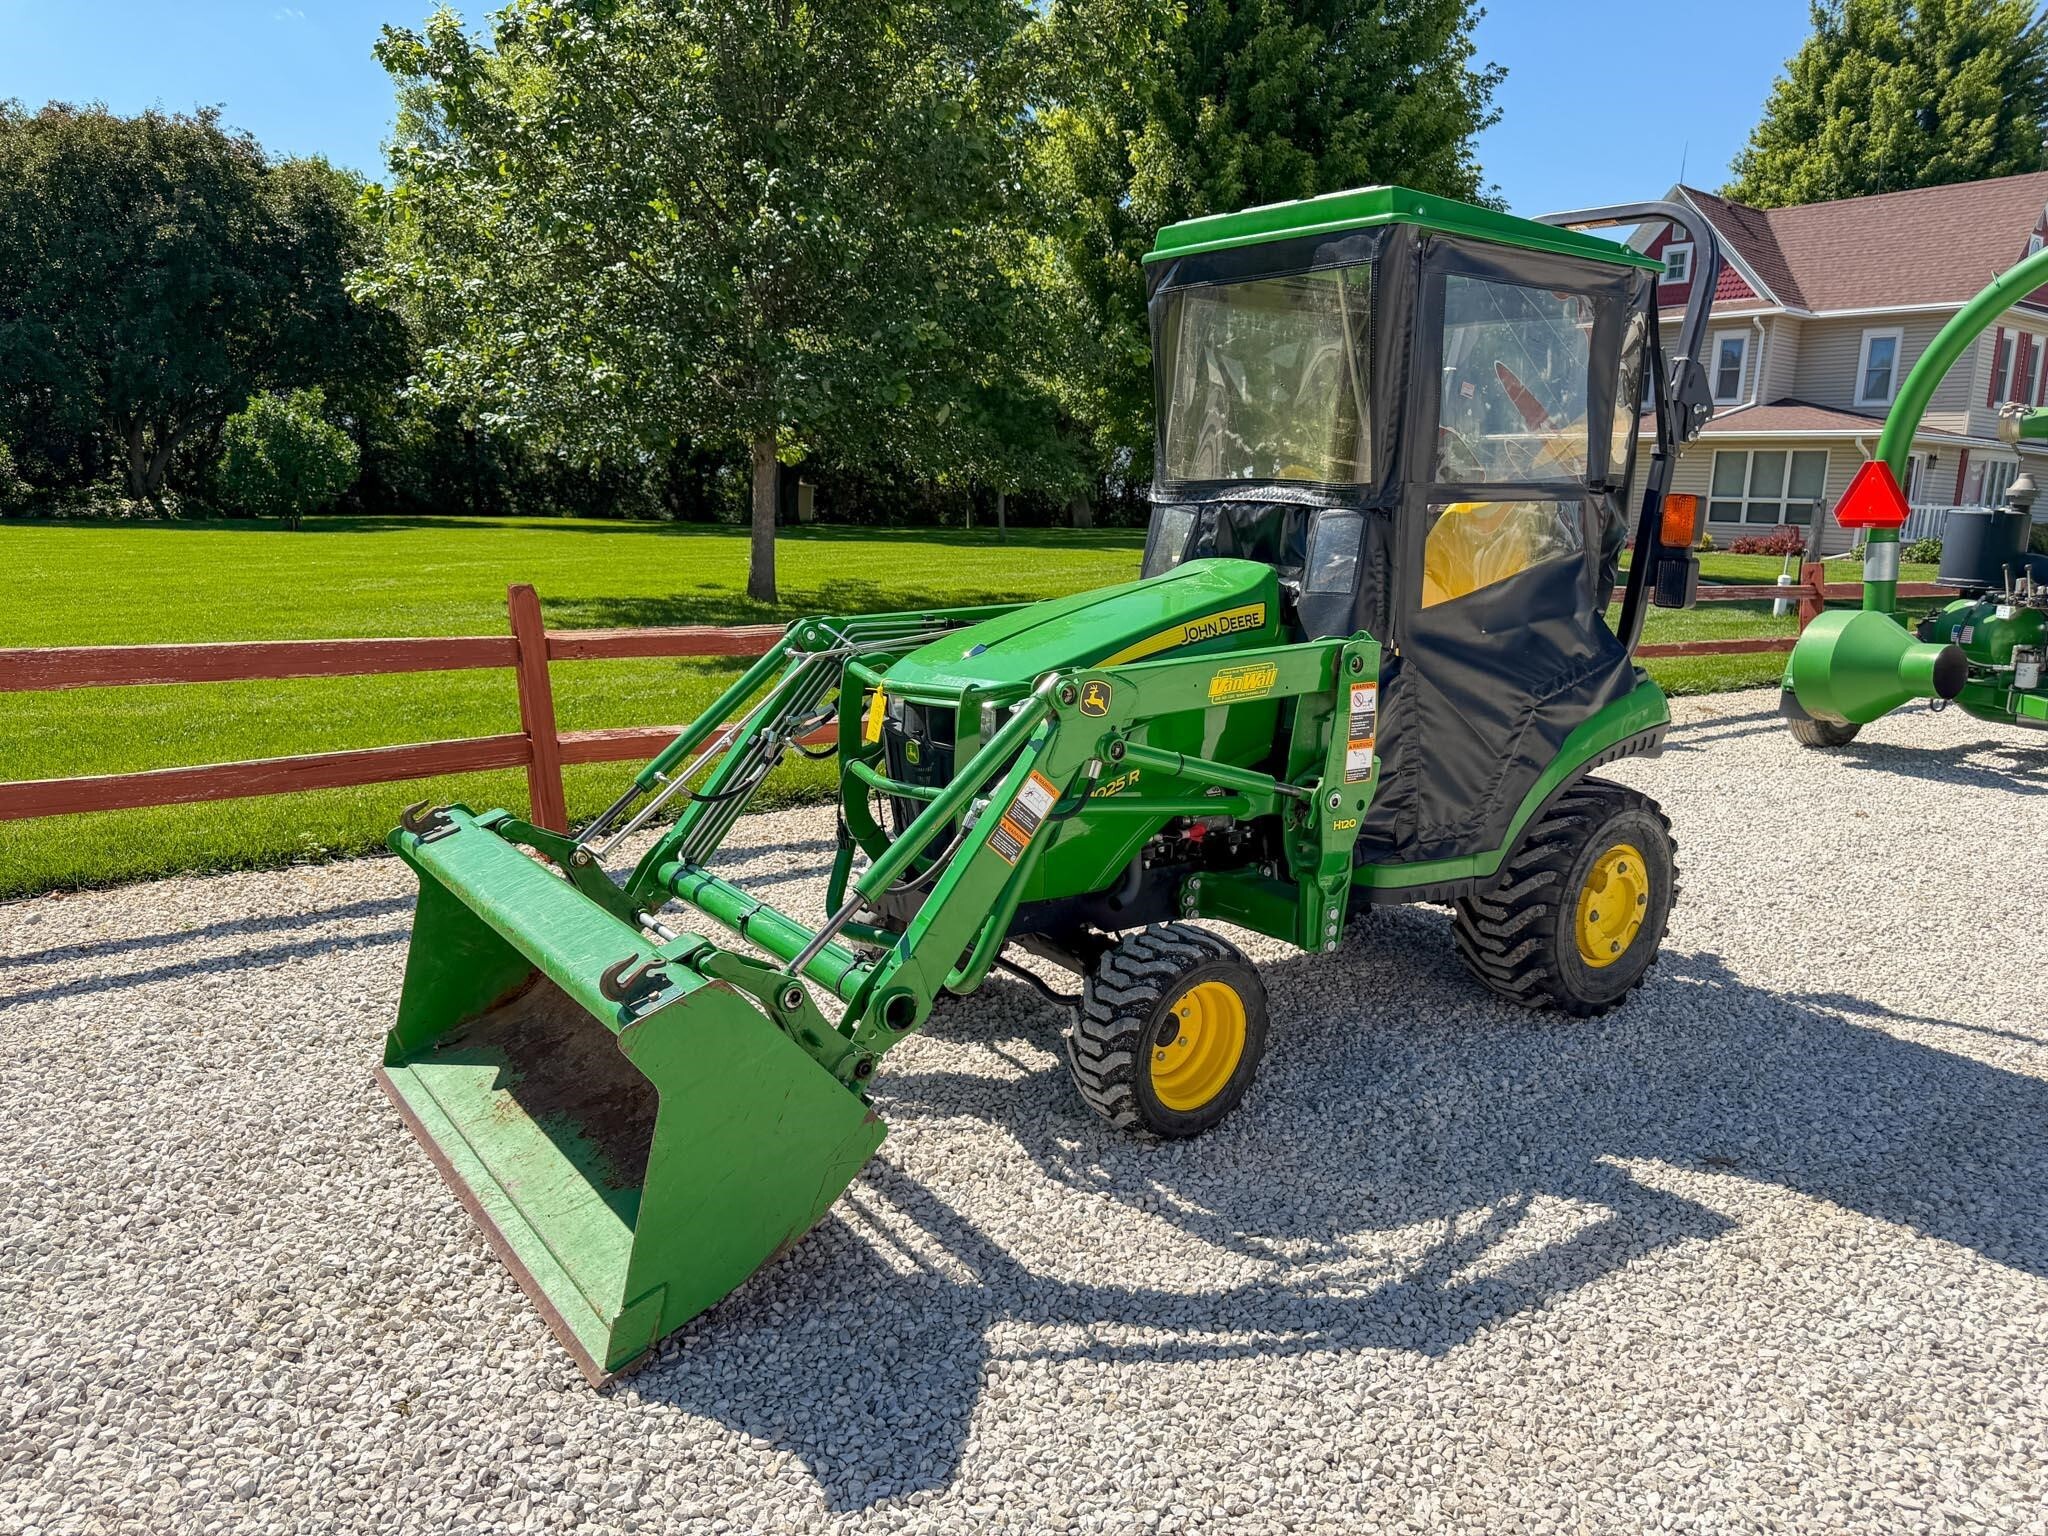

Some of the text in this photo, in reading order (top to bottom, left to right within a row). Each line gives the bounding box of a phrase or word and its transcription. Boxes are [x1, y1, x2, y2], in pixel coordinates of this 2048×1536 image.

[1181, 612, 1260, 644] JOHN DEERE
[1210, 670, 1276, 696] VanWall
[1333, 818, 1357, 831] H120
